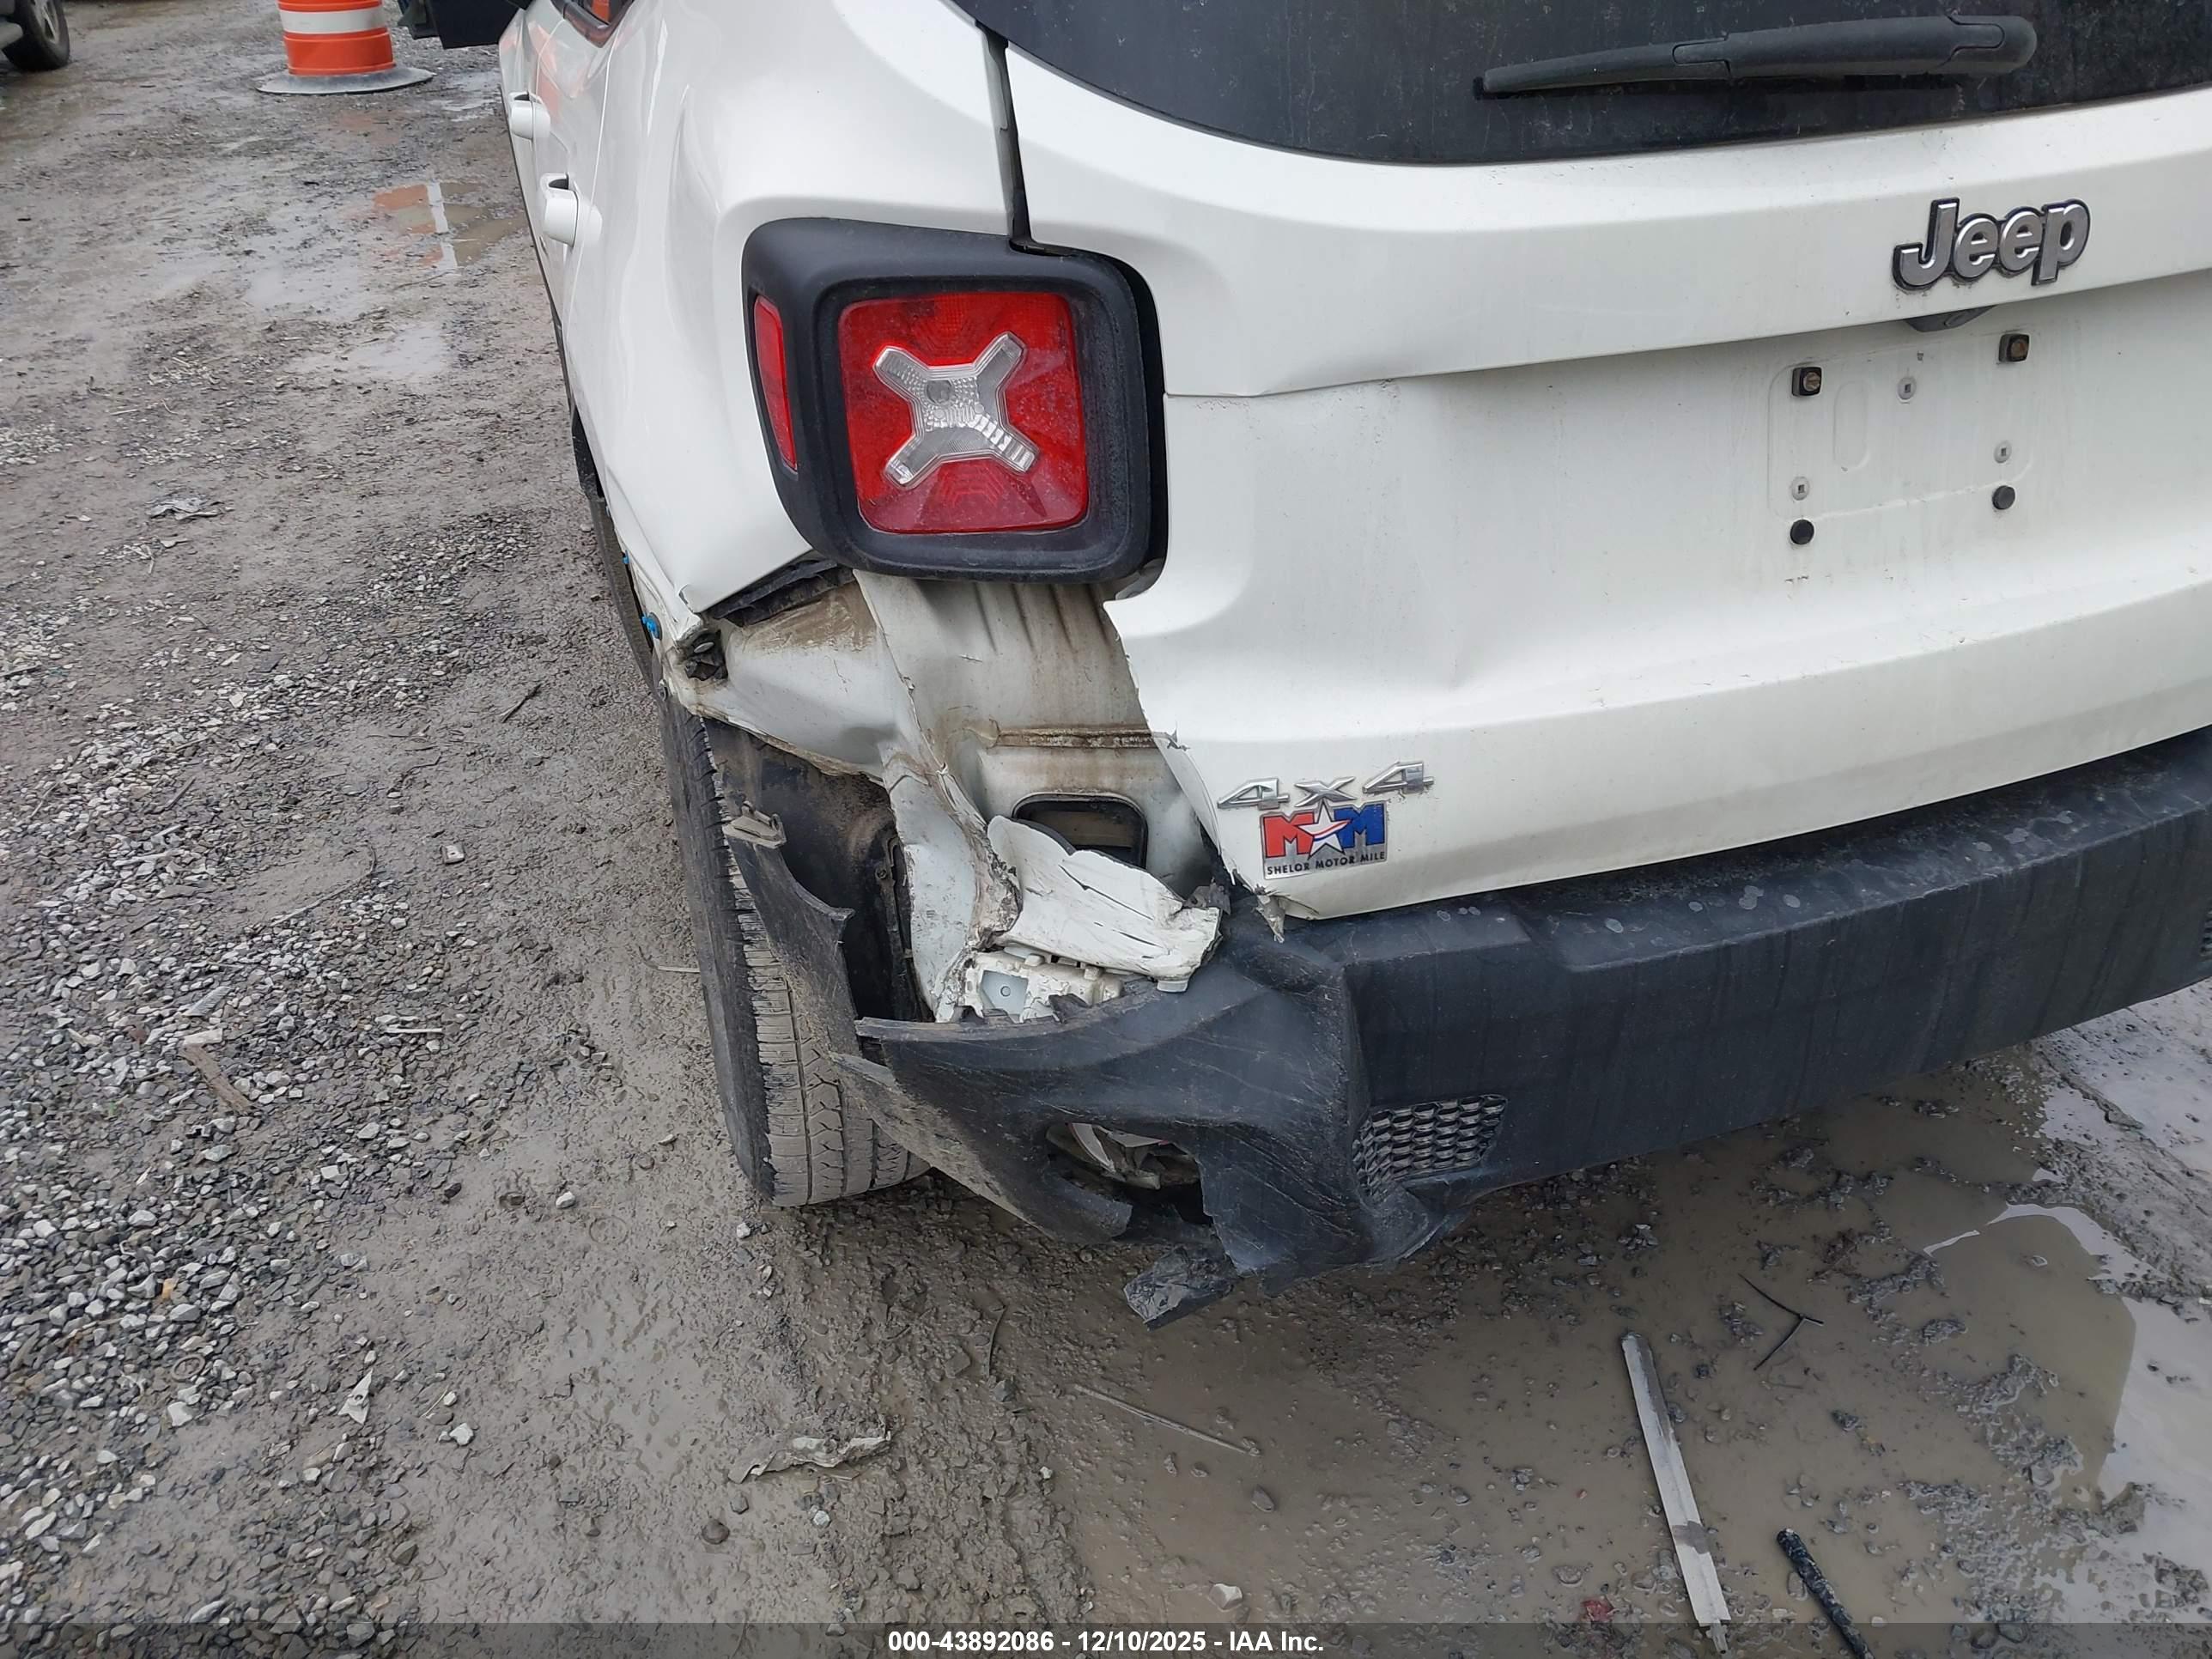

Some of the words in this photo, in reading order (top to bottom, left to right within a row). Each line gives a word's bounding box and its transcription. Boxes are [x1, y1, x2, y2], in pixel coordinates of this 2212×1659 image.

[1892, 197, 2091, 291] Jeep
[1267, 862, 1310, 875] SHELOR
[1315, 855, 1356, 869] MOTOR
[1360, 851, 1385, 863] MILE
